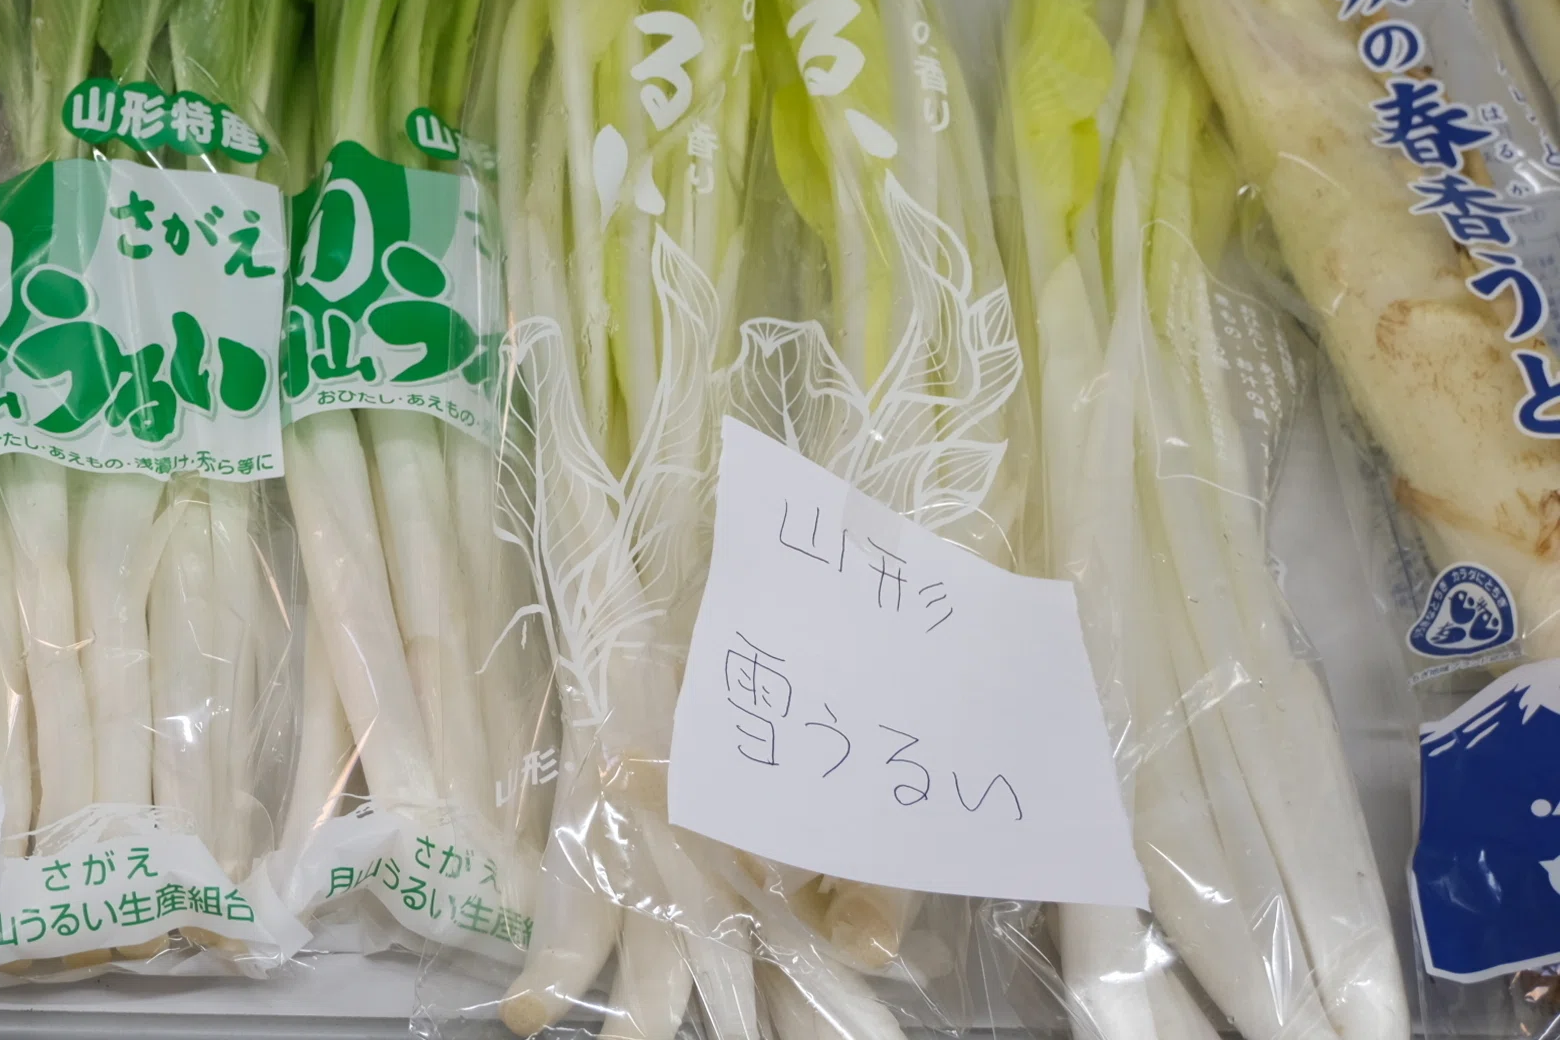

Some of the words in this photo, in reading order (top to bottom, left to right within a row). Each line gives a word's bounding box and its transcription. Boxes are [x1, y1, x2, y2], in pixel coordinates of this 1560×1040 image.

[72, 86, 263, 156] 山形特産
[109, 189, 277, 279] さがえ
[778, 498, 954, 634] 山形
[725, 630, 1024, 822] 雪うるい
[42, 846, 159, 892] さがえ
[414, 835, 502, 894] さがえ
